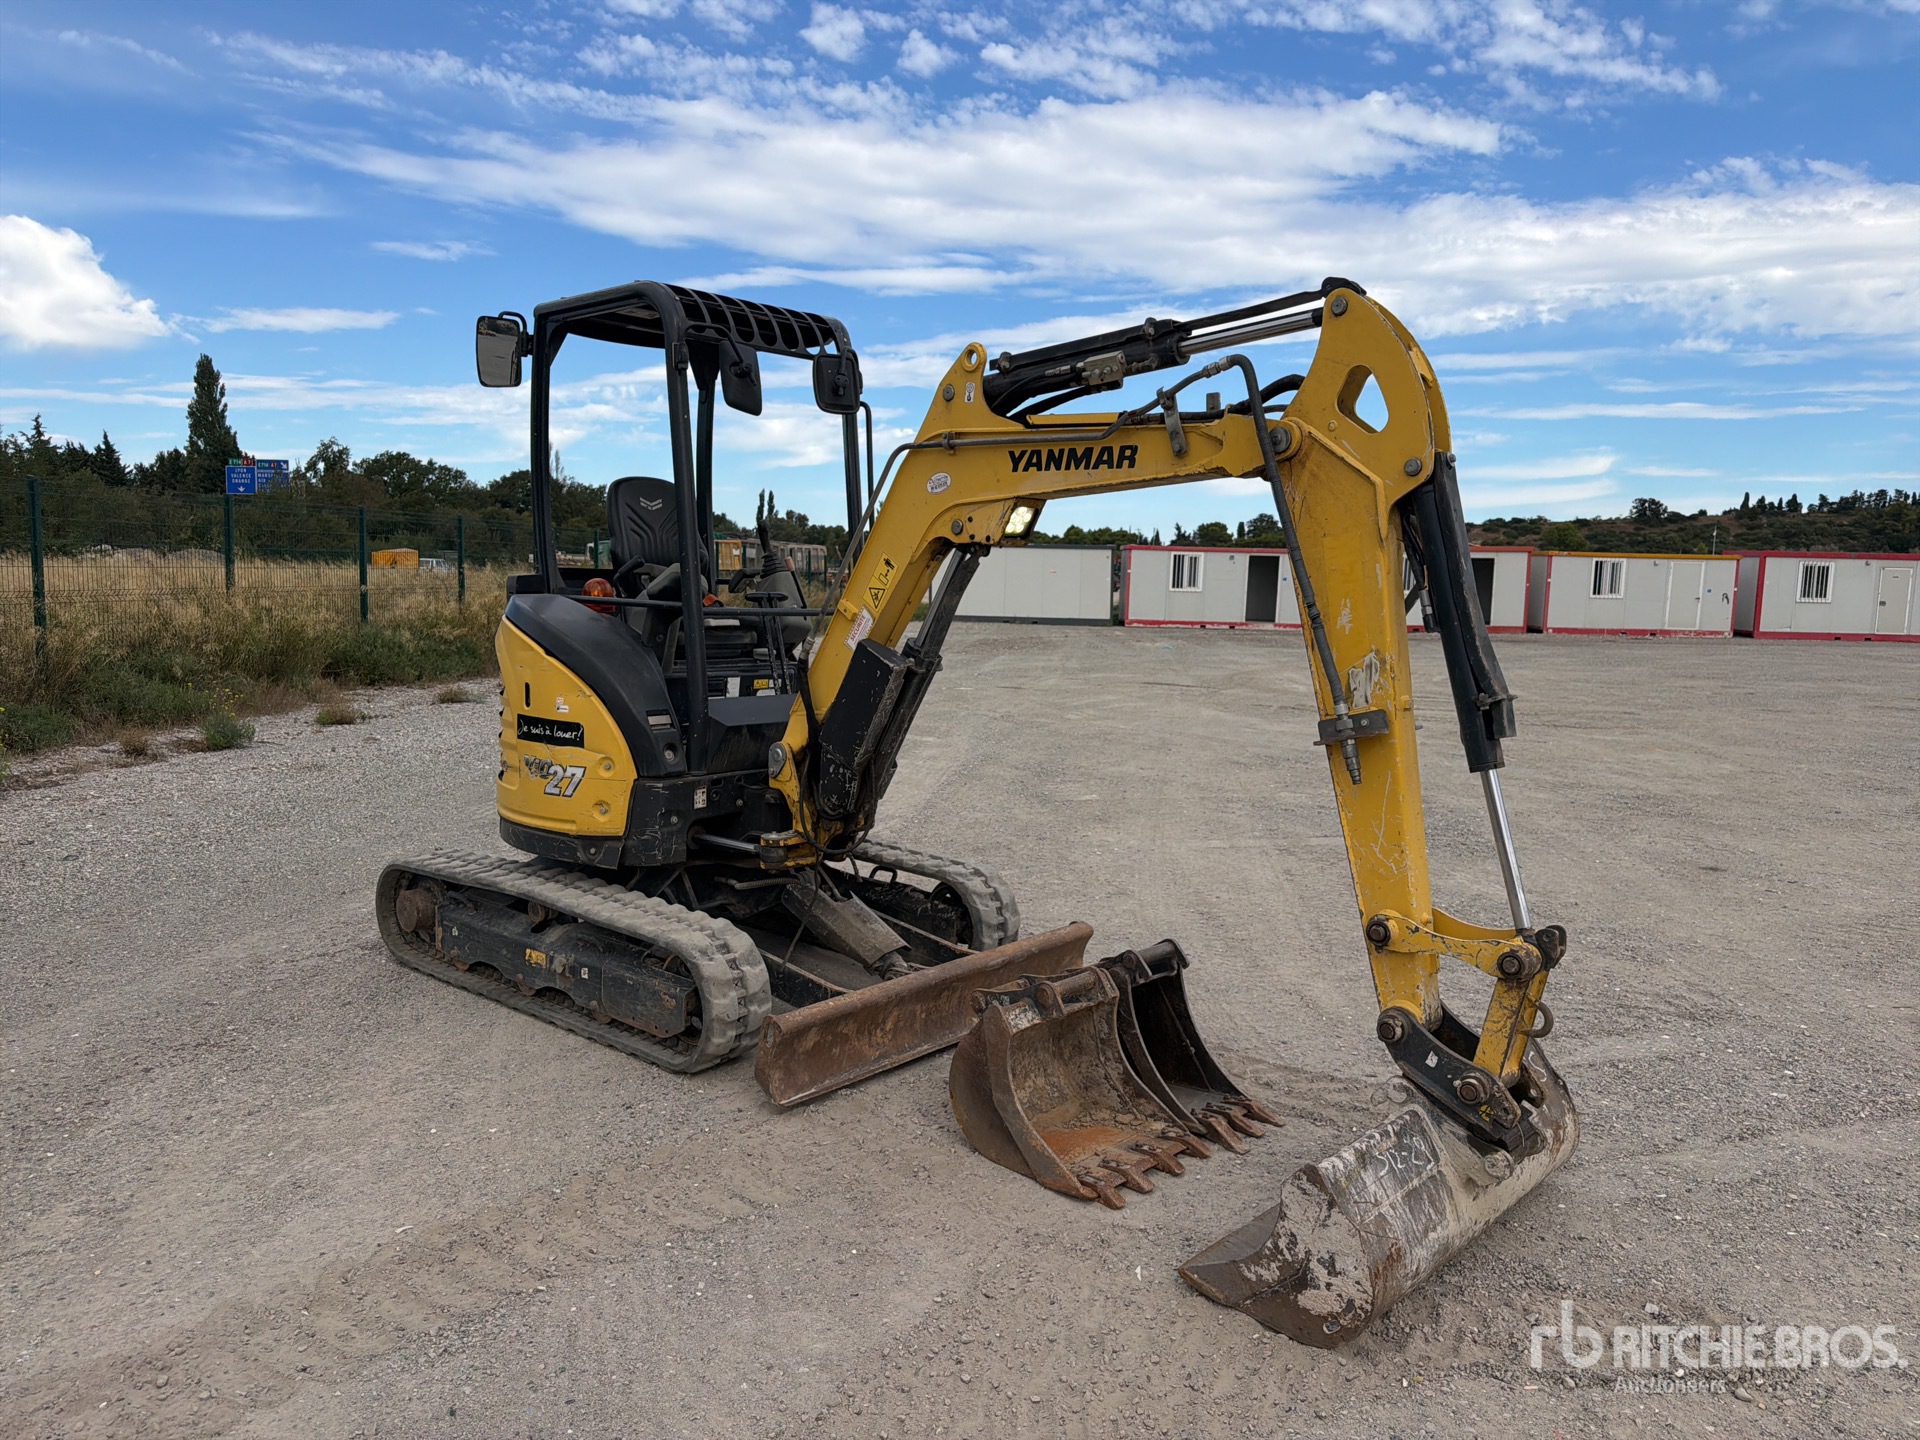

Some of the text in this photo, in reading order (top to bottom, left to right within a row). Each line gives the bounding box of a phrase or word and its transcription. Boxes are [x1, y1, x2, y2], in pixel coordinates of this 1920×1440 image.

[1008, 444, 1139, 473] YANMAR
[517, 718, 529, 736] Je
[530, 723, 544, 735] suis
[545, 725, 552, 736] à
